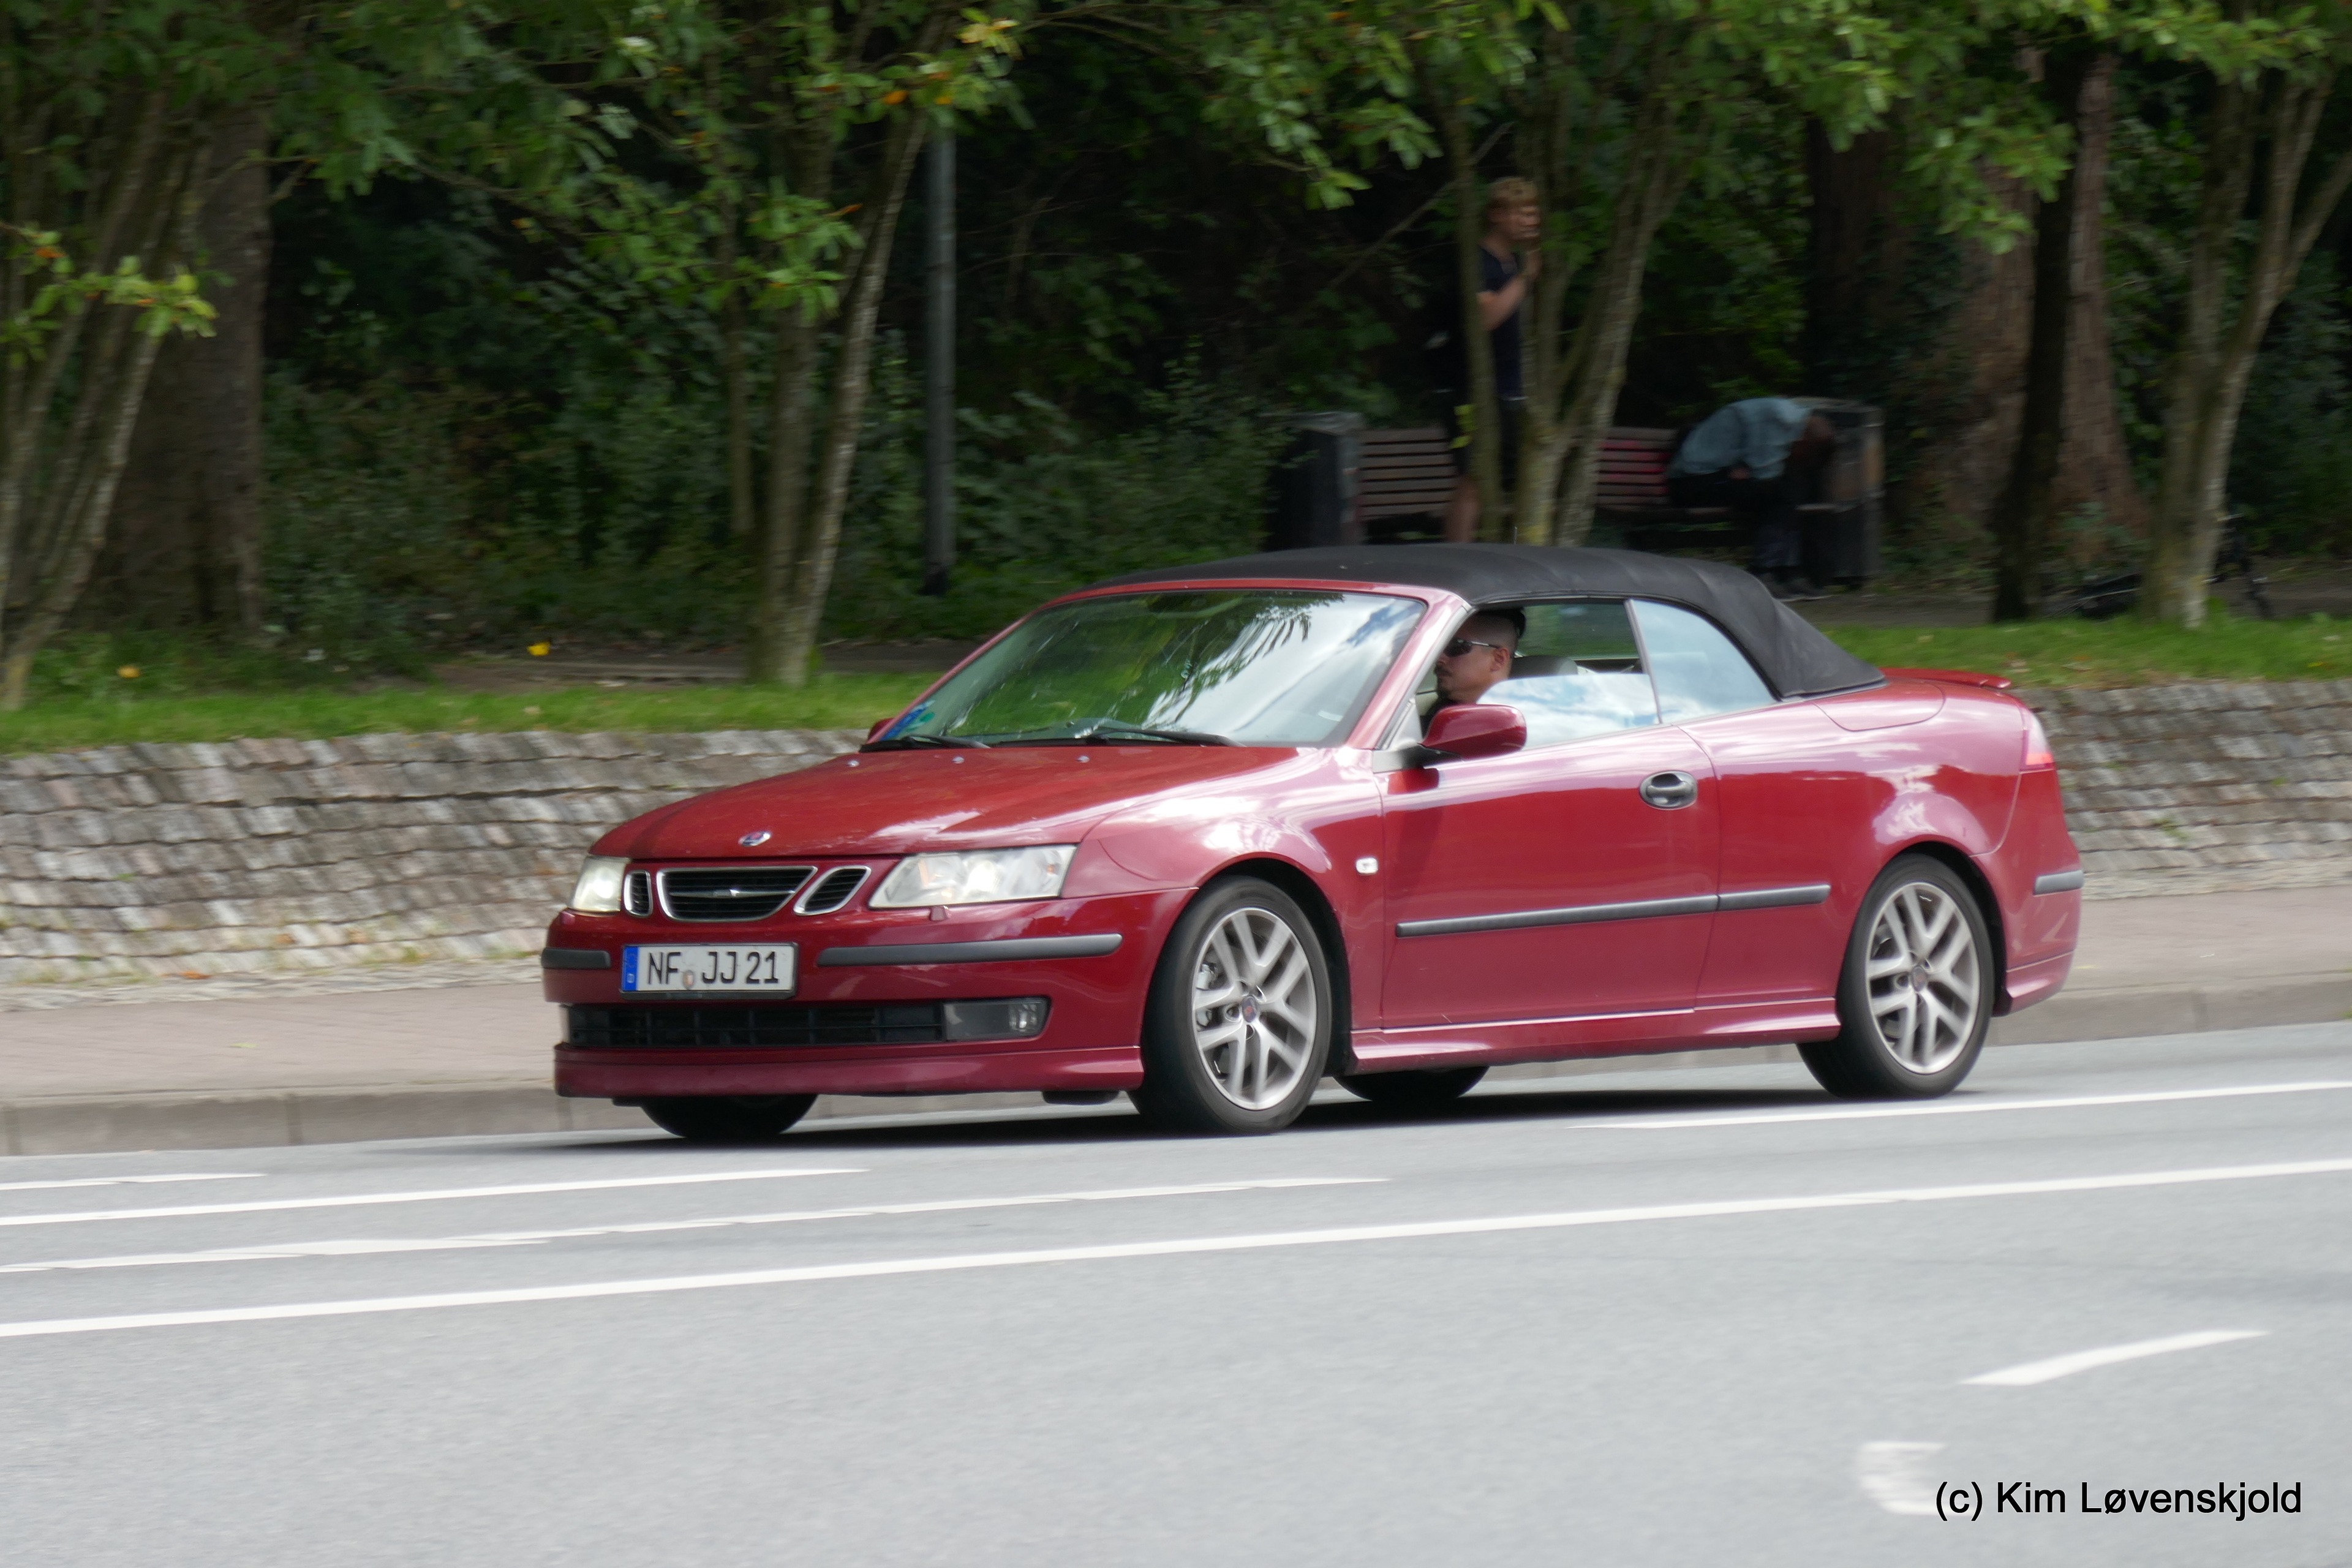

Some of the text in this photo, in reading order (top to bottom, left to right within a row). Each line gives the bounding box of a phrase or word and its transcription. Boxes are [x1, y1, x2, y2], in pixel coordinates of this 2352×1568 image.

[647, 951, 779, 984] NF JJ 21
